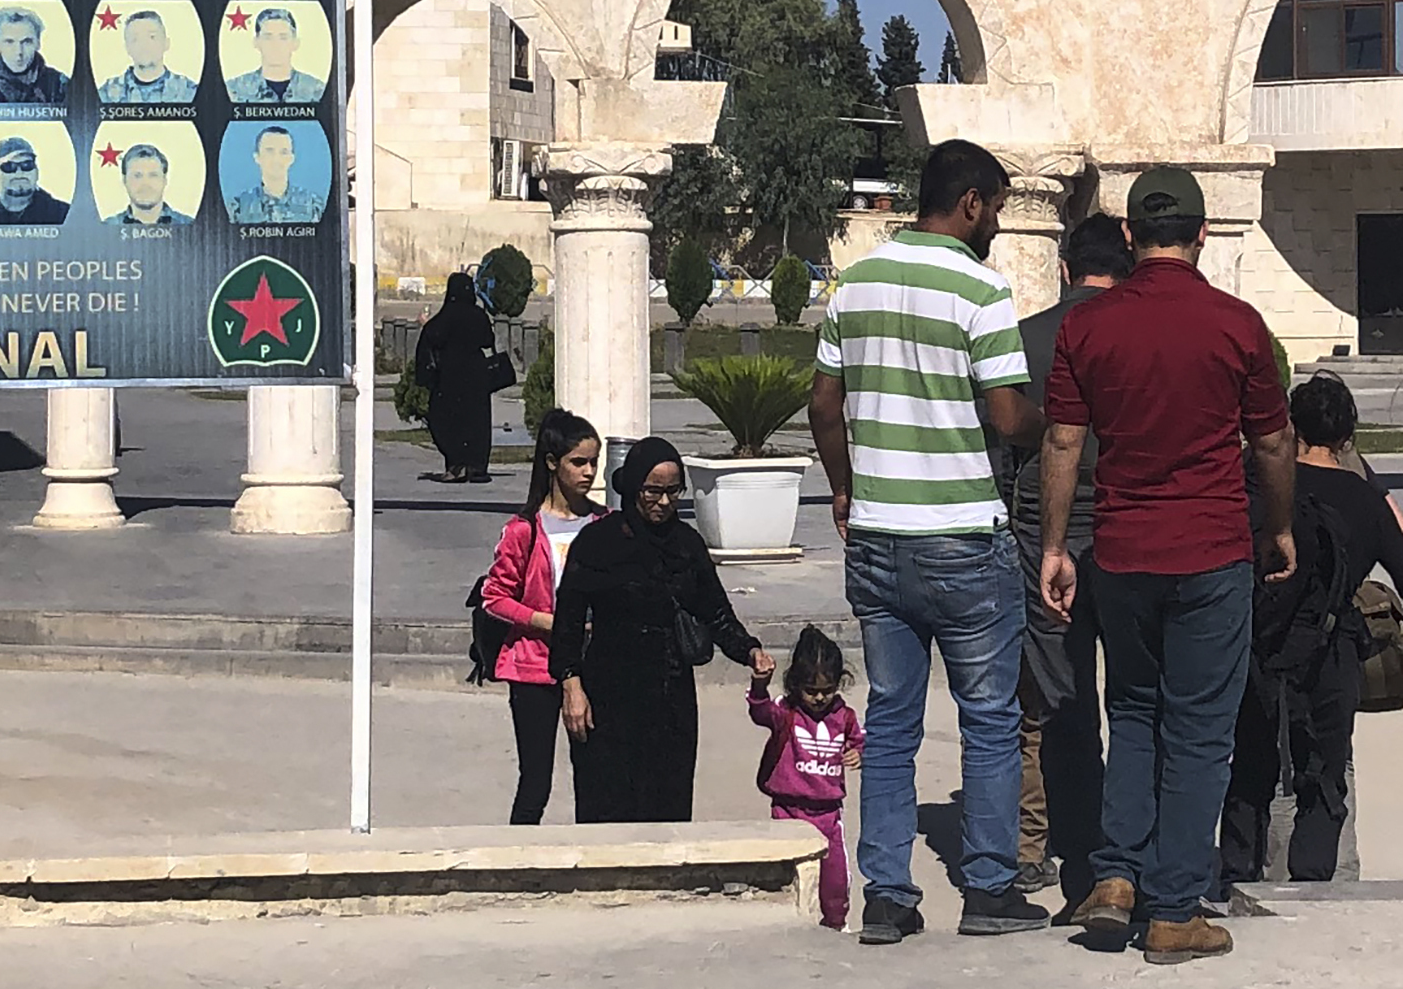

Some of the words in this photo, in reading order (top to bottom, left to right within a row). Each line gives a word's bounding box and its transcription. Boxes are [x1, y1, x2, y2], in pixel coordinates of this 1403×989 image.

[146, 107, 197, 118] AMANOS
[245, 107, 315, 118] BERXWEDAN
[24, 227, 60, 238] AMED
[37, 260, 143, 283] PEOPLES
[2, 292, 80, 314] NEVER
[87, 292, 127, 313] DIE
[796, 759, 842, 777] adidas
